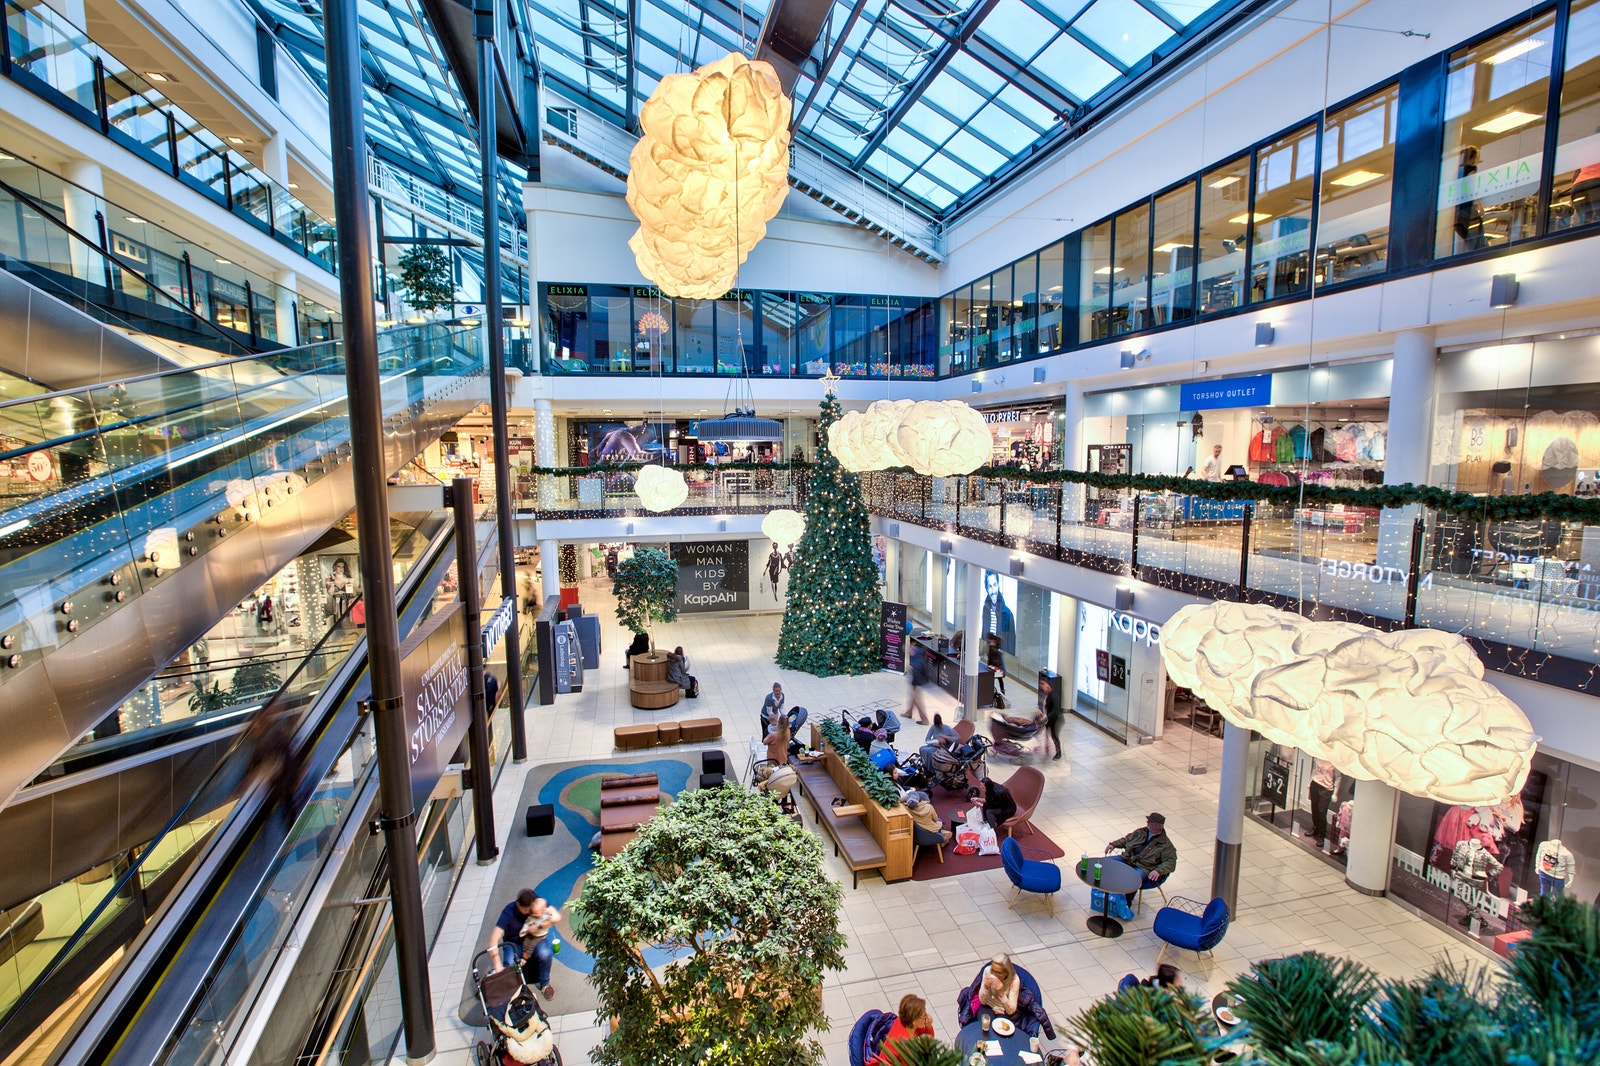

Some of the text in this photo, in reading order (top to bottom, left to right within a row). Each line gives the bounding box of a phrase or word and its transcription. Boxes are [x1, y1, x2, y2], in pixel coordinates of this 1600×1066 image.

[1447, 161, 1530, 198] ELIXIA
[550, 286, 584, 296] ELIXIA
[800, 296, 830, 304] ELIXIA
[871, 298, 900, 306] ELIXIA
[1193, 387, 1256, 401] TORSHOV OUTLET
[686, 544, 733, 554] WOMAN
[696, 557, 723, 566] MAN
[695, 569, 726, 579] KIDS
[703, 581, 719, 591] BY
[684, 591, 737, 605] KappAhl
[417, 650, 463, 725] SANDVIKA
[411, 666, 470, 765] STORSENTER
